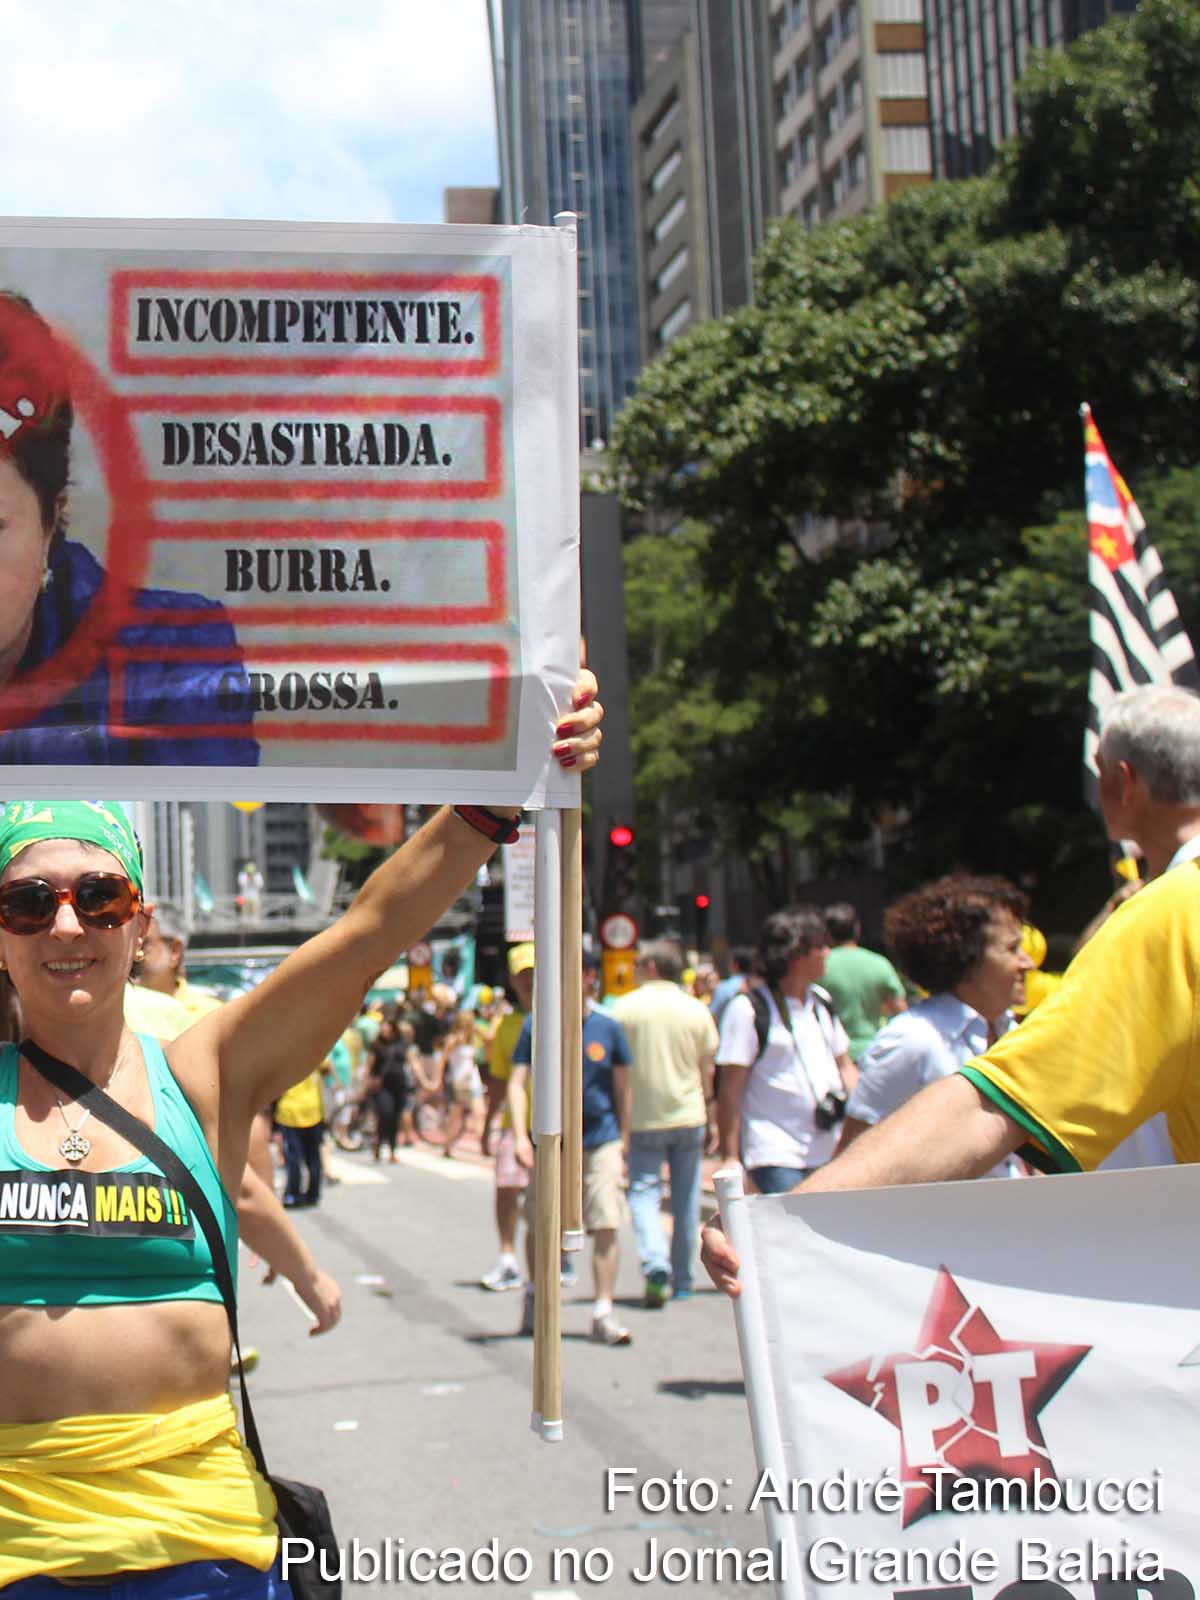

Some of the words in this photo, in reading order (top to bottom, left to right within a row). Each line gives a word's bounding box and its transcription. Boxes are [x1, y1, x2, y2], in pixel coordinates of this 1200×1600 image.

[136, 297, 475, 345] INCOMPETENTE.
[162, 422, 452, 466] DESASTRADA.
[225, 548, 391, 593] BURRA.
[218, 671, 400, 711] GROSSA.
[0, 1182, 89, 1221] NUNCA
[894, 1349, 1037, 1468] PT
